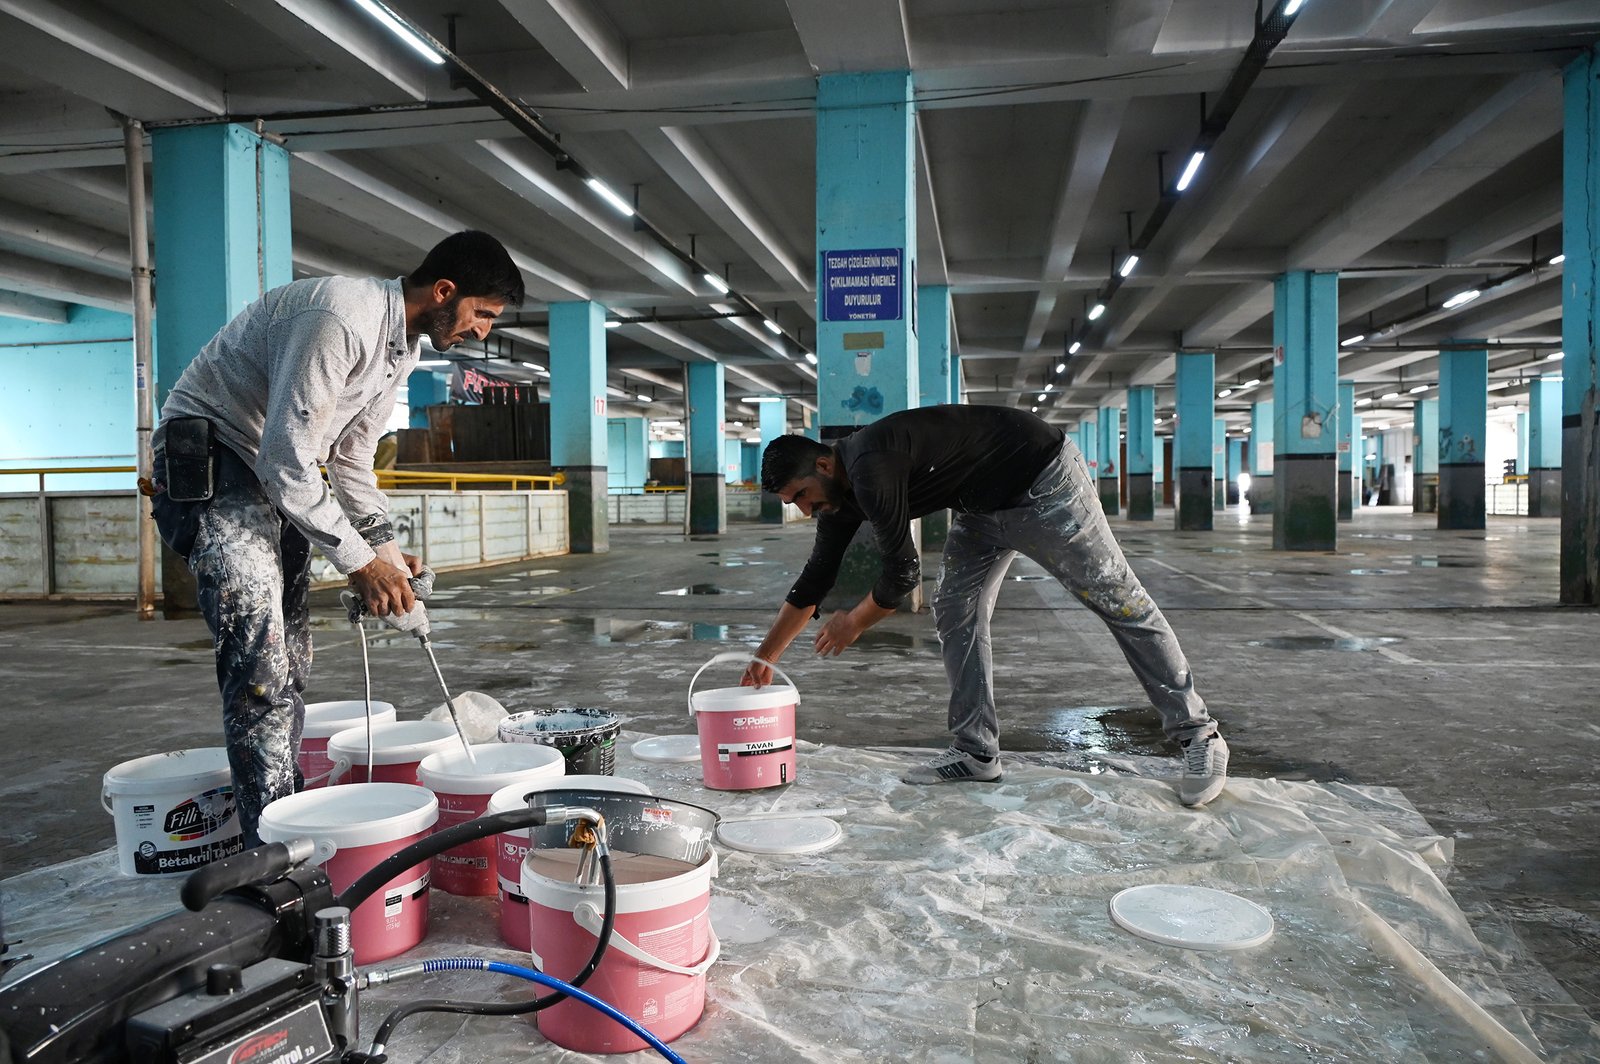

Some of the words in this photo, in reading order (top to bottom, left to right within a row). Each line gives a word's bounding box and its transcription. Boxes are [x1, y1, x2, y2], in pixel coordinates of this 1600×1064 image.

[828, 257, 847, 269] TEZGAH
[881, 256, 898, 270] DIŞINA
[830, 276, 869, 290] ÇIKILMAMASI
[870, 273, 896, 287] ÖNEMLE
[844, 294, 881, 306] DUYURULUR
[848, 312, 877, 320] YÖNETİM
[596, 399, 605, 416] 17
[747, 715, 779, 725] Polisan
[746, 741, 774, 750] TAVAN
[170, 805, 199, 829] Filli
[159, 850, 210, 868] Betakril
[213, 842, 243, 859] Tavan
